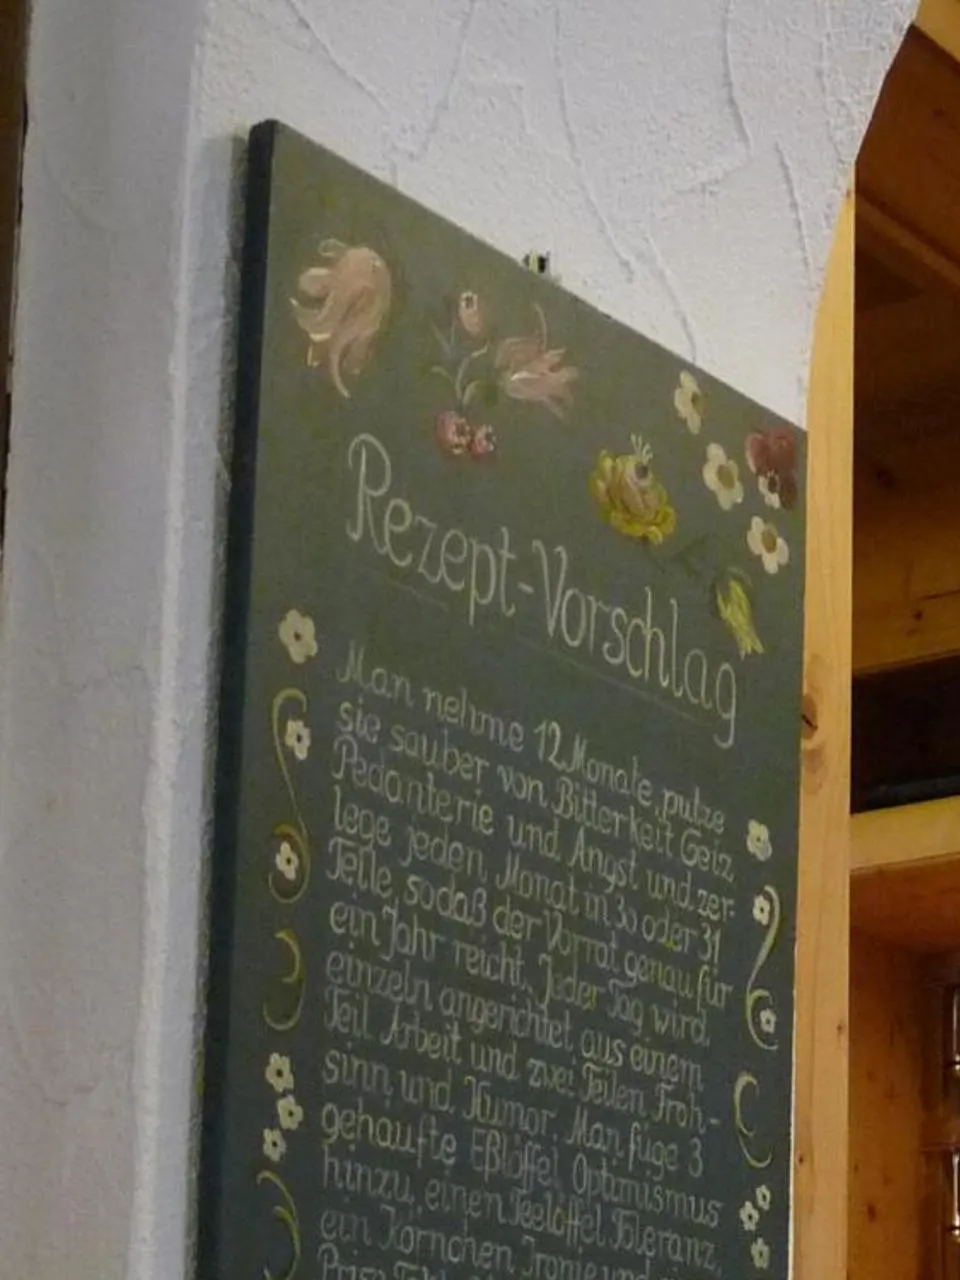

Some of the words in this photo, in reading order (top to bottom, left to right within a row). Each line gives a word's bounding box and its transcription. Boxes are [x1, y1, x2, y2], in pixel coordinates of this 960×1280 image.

[347, 432, 736, 749] Rezept-Vorschlag
[336, 640, 414, 708] Man
[422, 686, 524, 752] nehme
[534, 719, 563, 768] 12
[336, 695, 381, 744] sie
[390, 724, 490, 784] sauber
[497, 763, 548, 808] von
[332, 733, 495, 836] Pedanterie
[507, 814, 560, 862] und
[646, 868, 696, 913] und
[333, 784, 392, 850] lege
[399, 818, 487, 883] jeden
[496, 849, 580, 916] Monat
[641, 904, 698, 954] oder
[698, 921, 722, 965] 31
[329, 892, 382, 947] ein
[380, 897, 446, 962] Jahr
[607, 979, 645, 1038] Tag
[649, 995, 711, 1048] wird
[404, 873, 487, 928] sodaß
[493, 893, 543, 942] der
[543, 908, 620, 974] Vorrat
[624, 950, 693, 1000] genau
[697, 963, 735, 1013] für
[324, 983, 374, 1041] Teil
[380, 1003, 462, 1066] Arbeit
[469, 1039, 521, 1082] und
[582, 1060, 648, 1118] Teilen
[651, 1081, 722, 1136] Froh-
[326, 940, 434, 1013] einzeln
[438, 986, 574, 1053] angerichtet
[580, 1027, 628, 1068] aus
[629, 1036, 705, 1094] einem
[320, 1040, 394, 1097] sinn
[399, 1068, 456, 1115] und
[564, 1104, 625, 1159] Man
[627, 1120, 679, 1182] füge
[687, 1136, 704, 1179] 3
[319, 1196, 373, 1247] ein
[423, 1167, 511, 1225] einen
[571, 1152, 726, 1230] Optimismus
